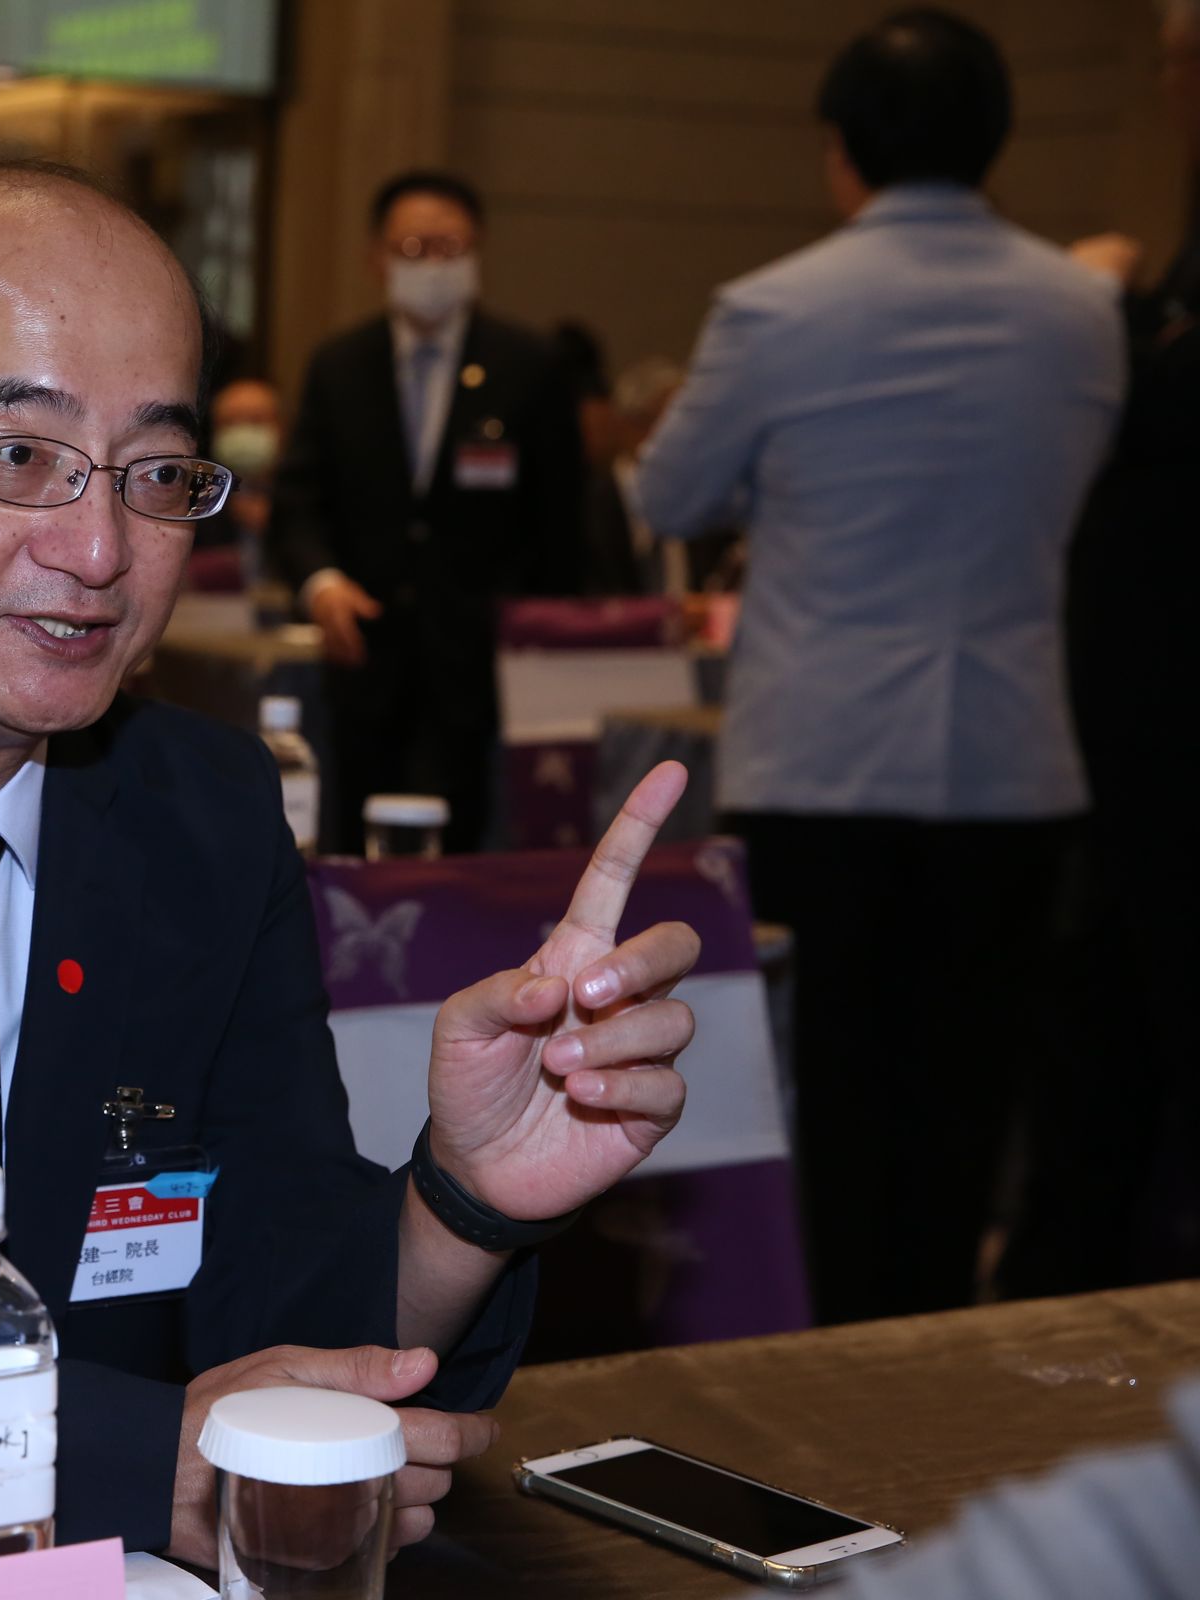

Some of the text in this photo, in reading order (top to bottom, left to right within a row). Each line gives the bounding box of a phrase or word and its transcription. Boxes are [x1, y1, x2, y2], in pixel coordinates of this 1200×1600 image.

[111, 1213, 164, 1225] WEDNESDAY
[168, 1210, 192, 1219] CLUB
[126, 1240, 159, 1259] 院長
